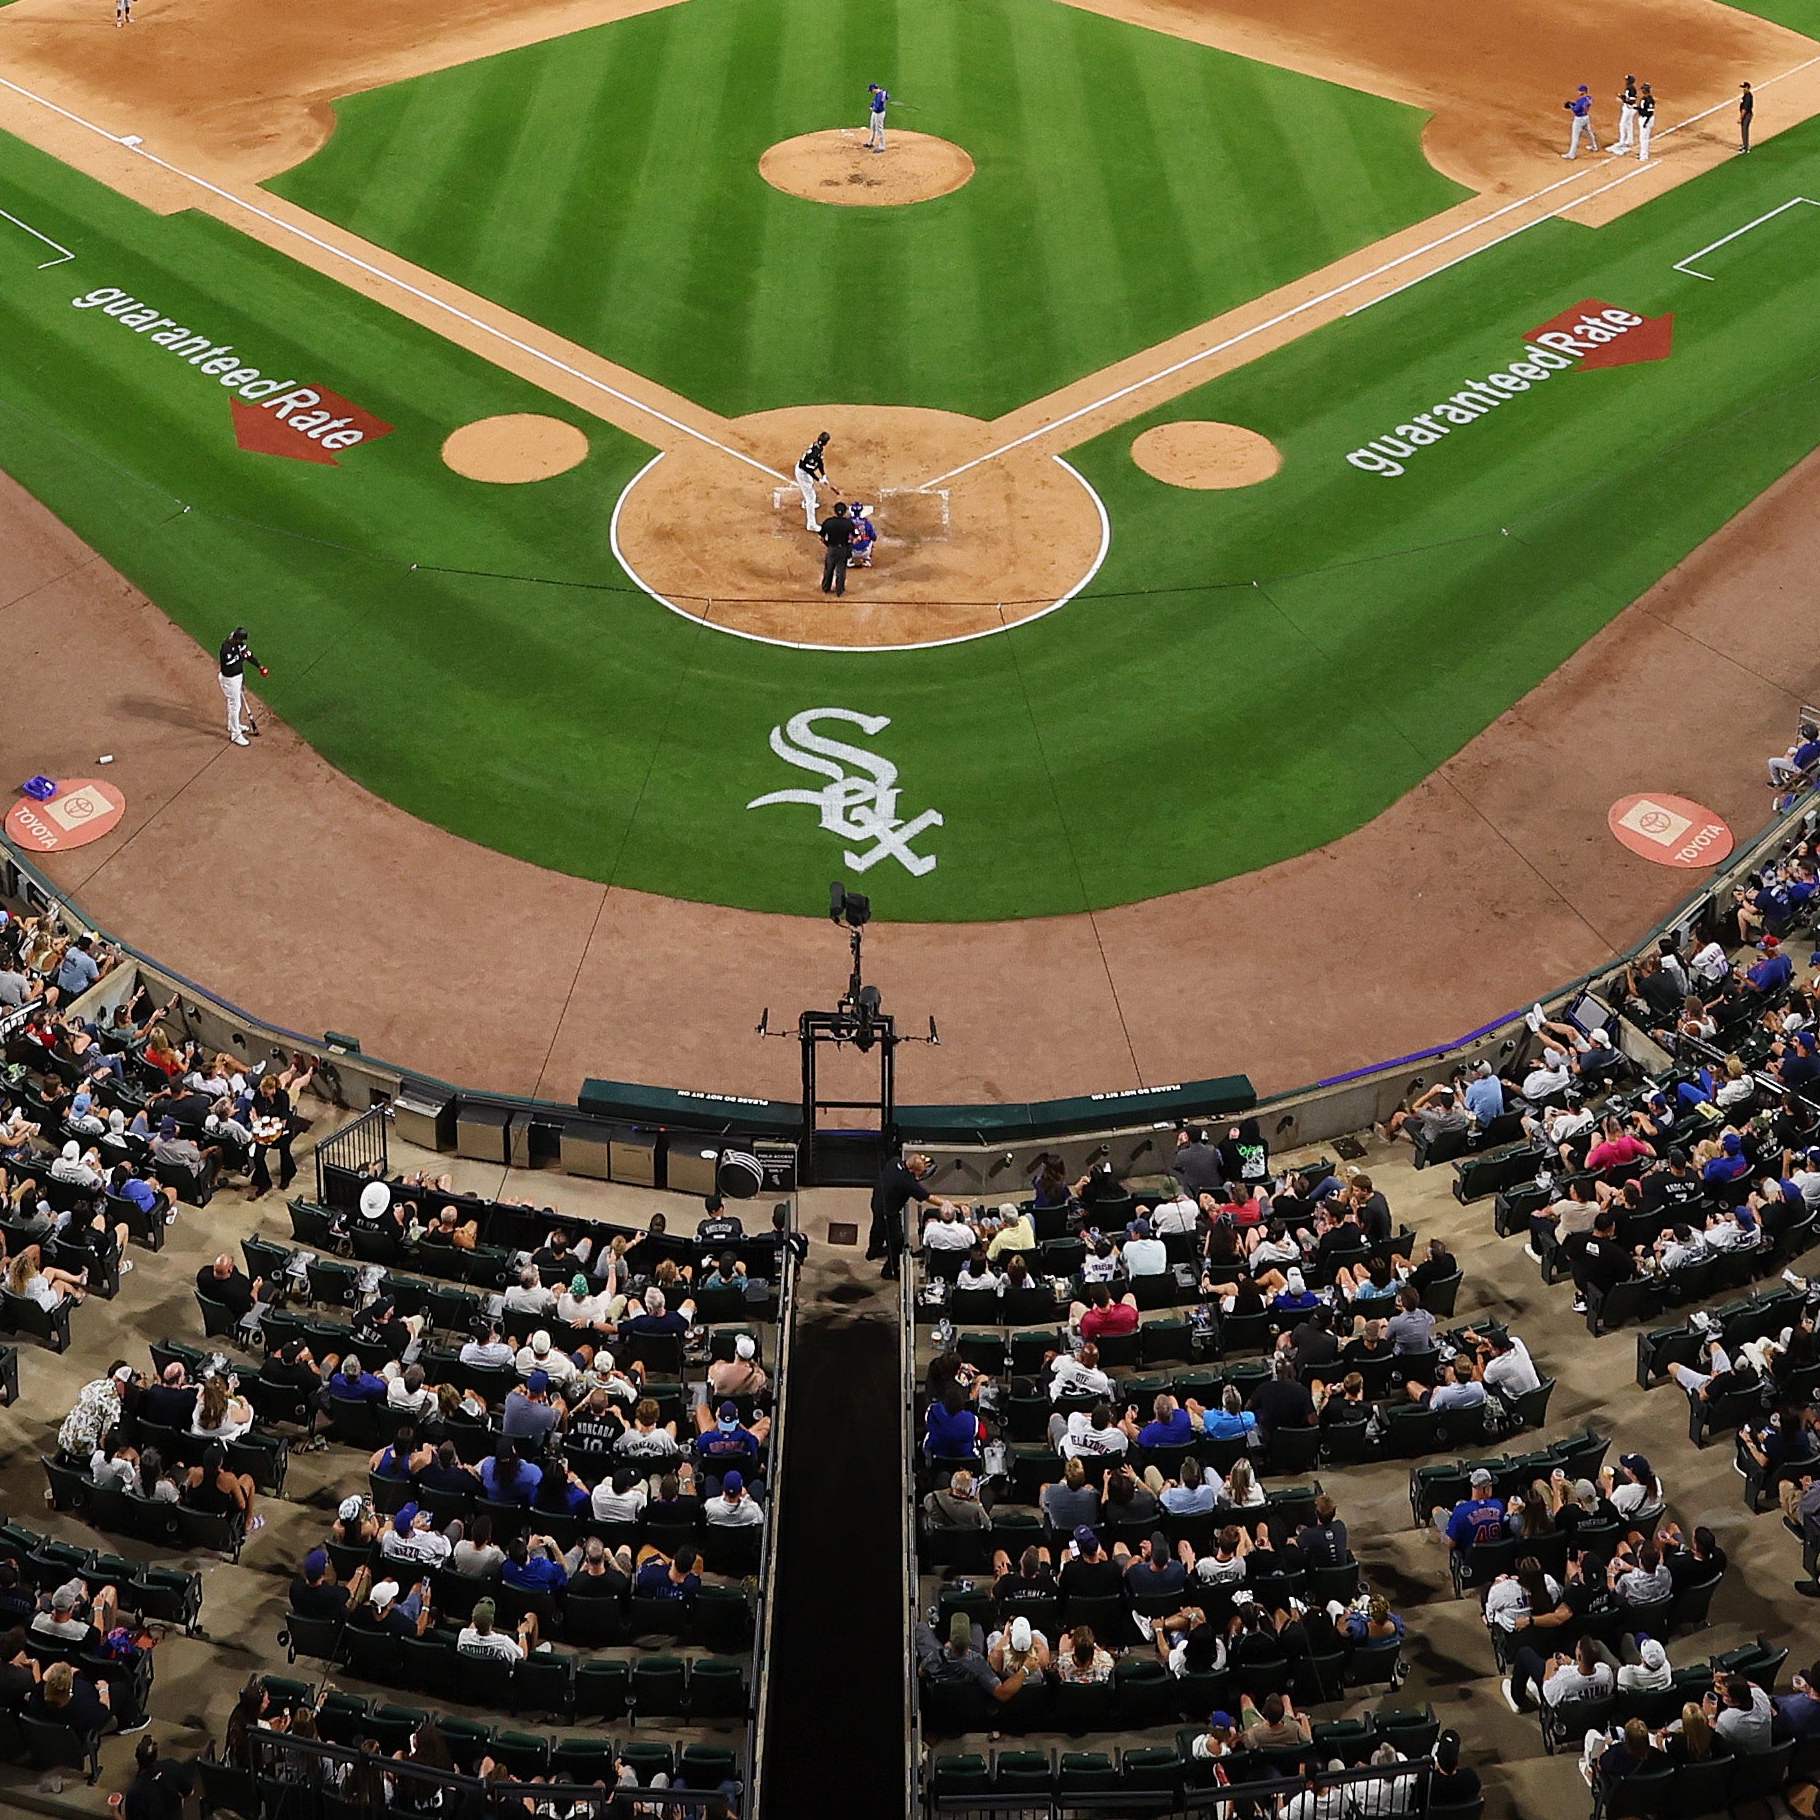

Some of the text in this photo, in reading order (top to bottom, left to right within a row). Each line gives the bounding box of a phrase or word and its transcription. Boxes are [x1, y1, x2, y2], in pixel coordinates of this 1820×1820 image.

[71, 287, 364, 450] guaranteed Rate
[1345, 308, 1644, 478] guaranteed Rate
[13, 806, 59, 850] TOYOTA
[1673, 823, 1725, 864] TOYOTA
